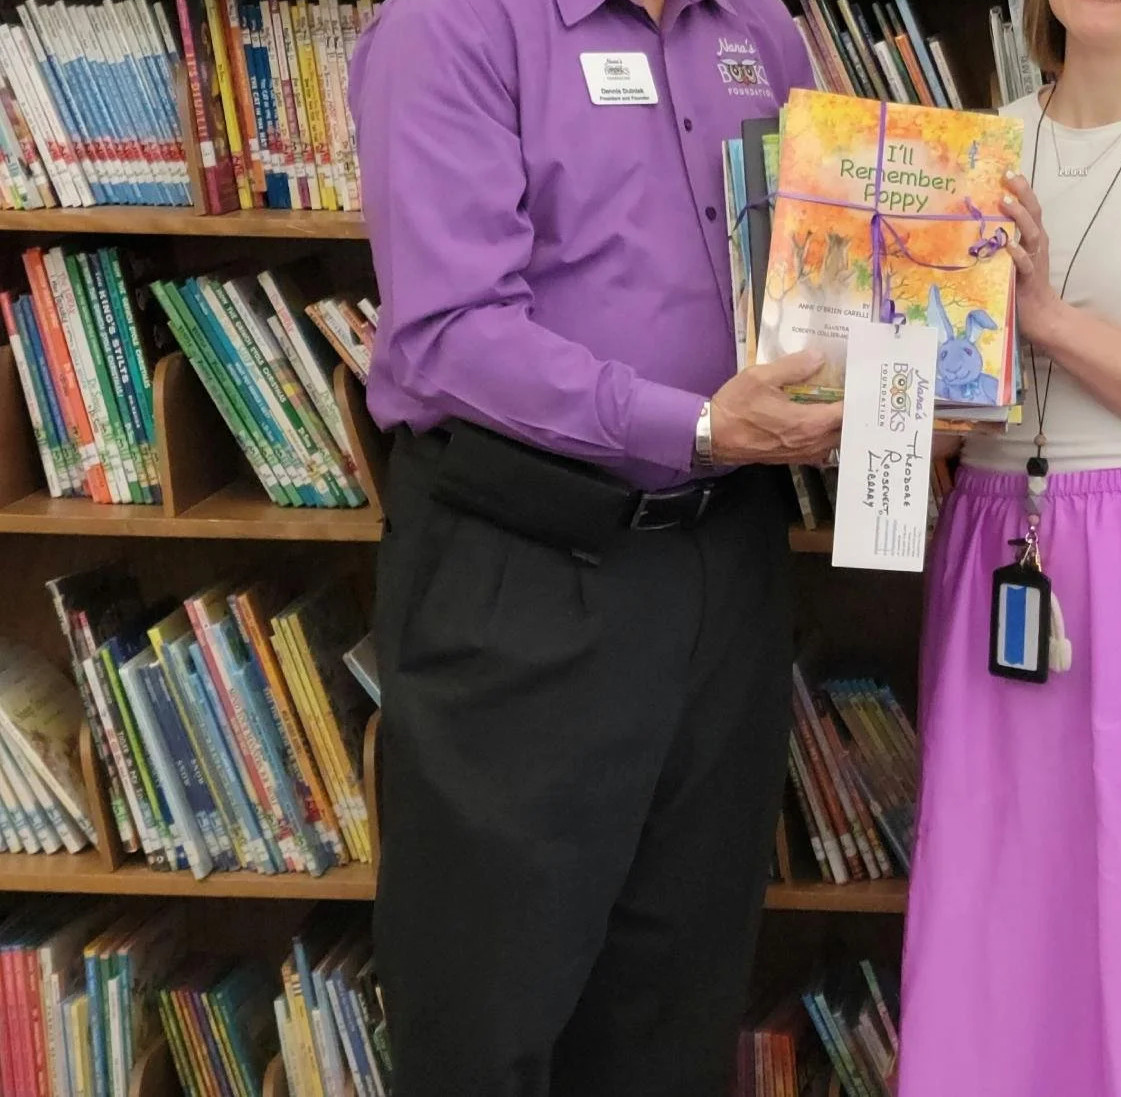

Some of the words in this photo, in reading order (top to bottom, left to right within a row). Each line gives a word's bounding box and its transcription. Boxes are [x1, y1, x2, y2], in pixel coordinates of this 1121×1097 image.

[716, 37, 756, 56] Nana's
[840, 159, 956, 194] Remember,
[887, 145, 913, 165] I'll
[864, 183, 928, 213] Poppy
[98, 289, 116, 335] KING'S
[111, 337, 129, 384] STILTS
[879, 363, 889, 427] FOUNDATION
[889, 362, 914, 433] BOOKS
[914, 369, 930, 421] Nana's
